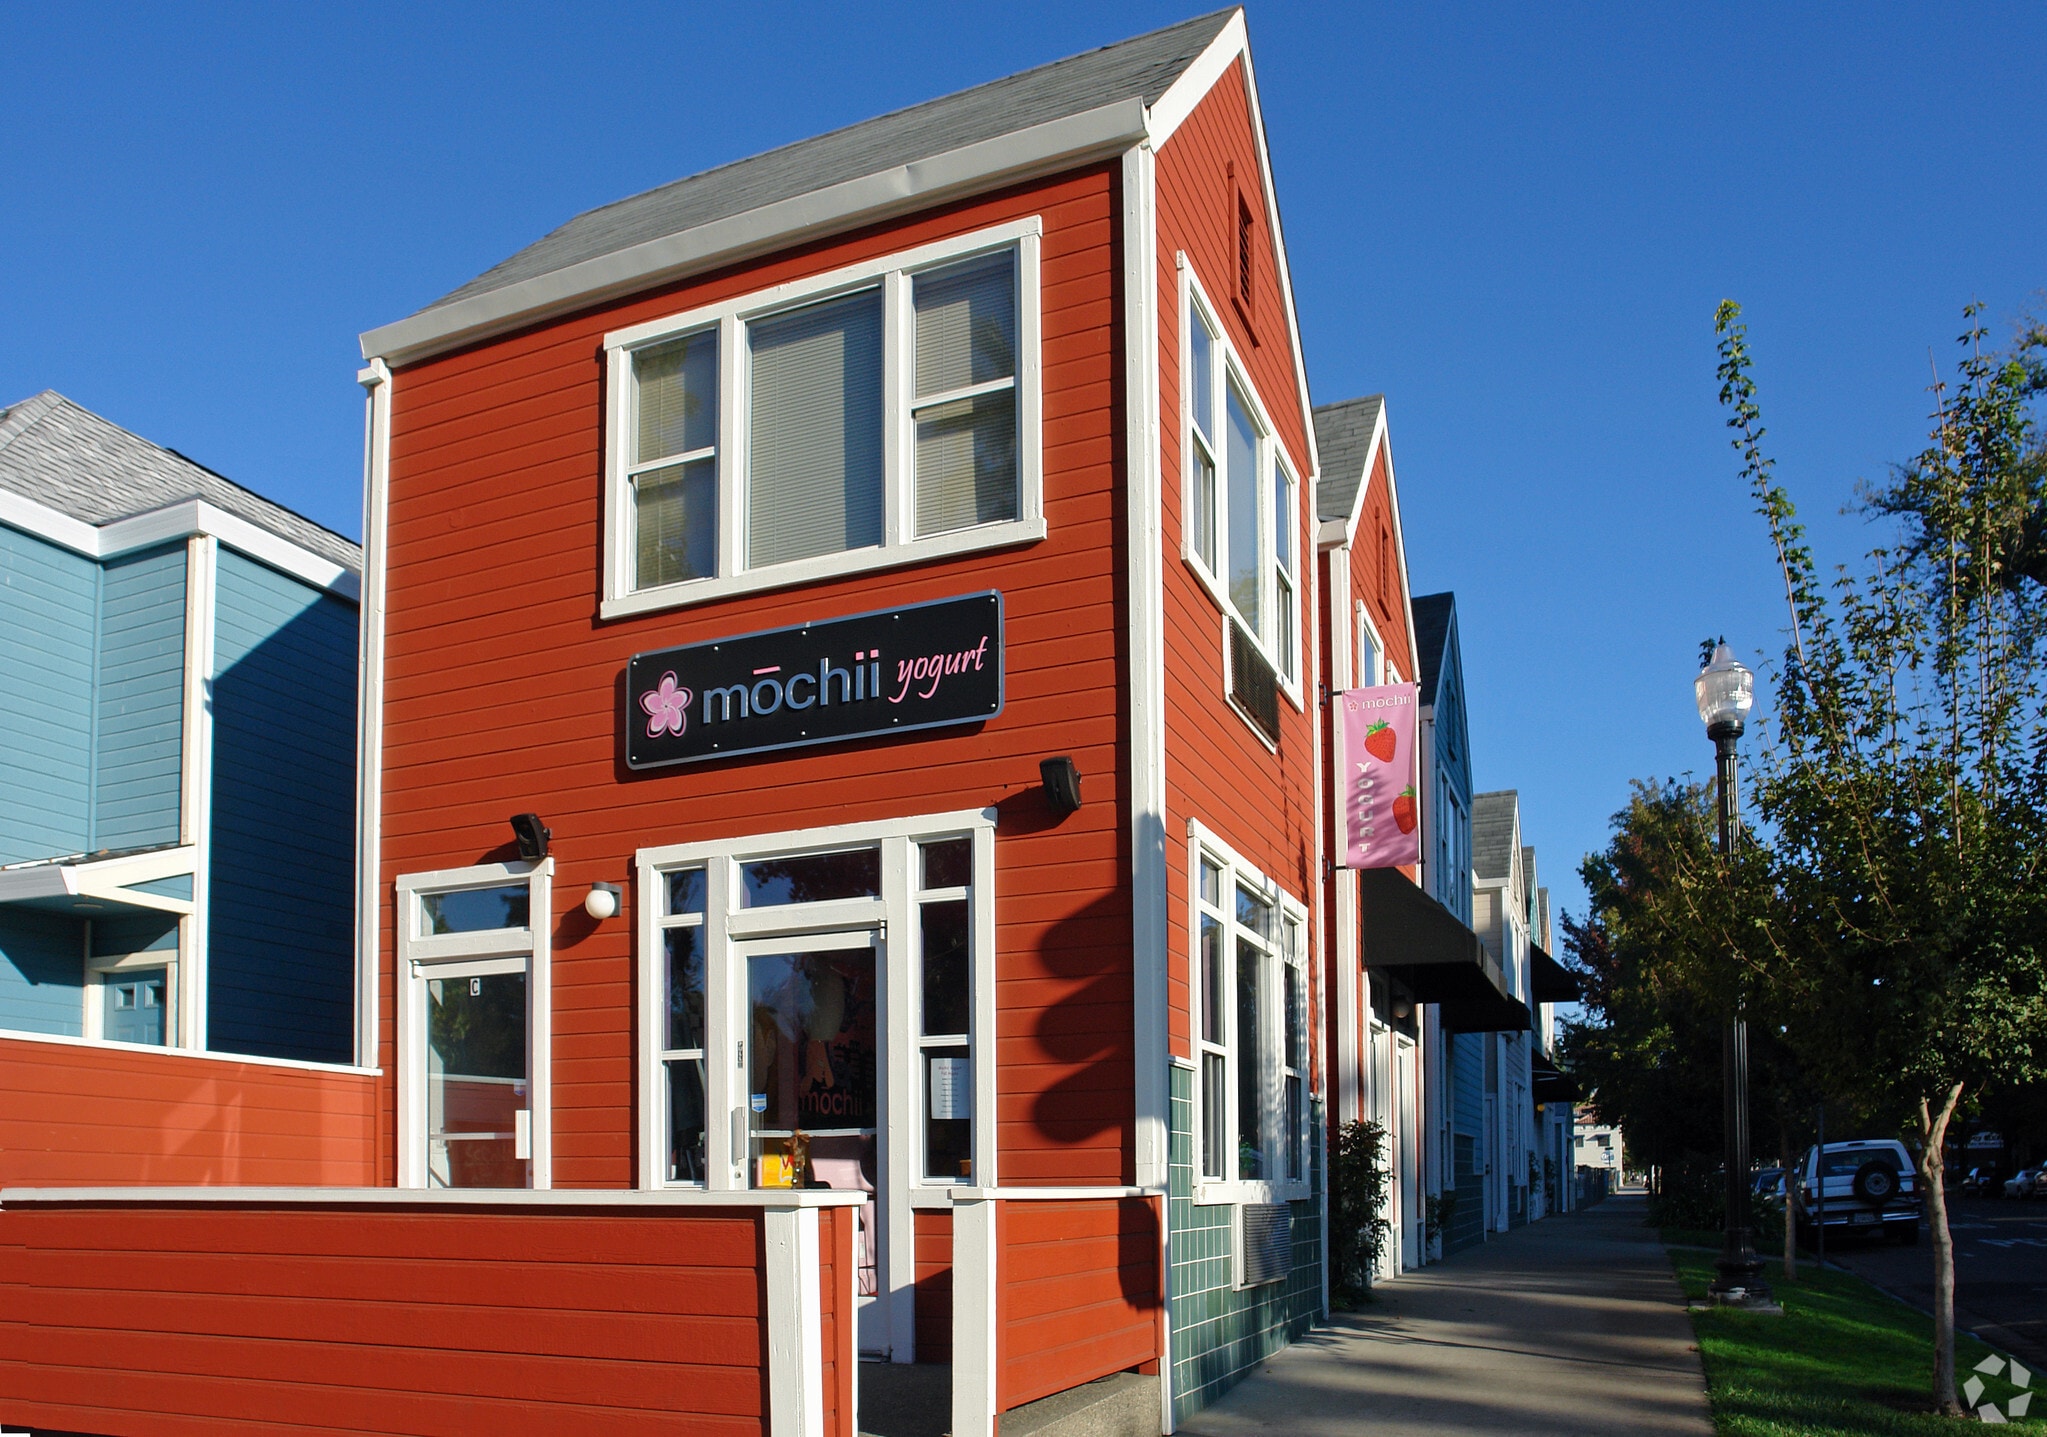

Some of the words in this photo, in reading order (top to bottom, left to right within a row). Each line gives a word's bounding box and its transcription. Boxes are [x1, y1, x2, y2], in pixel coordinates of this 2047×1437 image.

[887, 635, 989, 704] yogurt
[1356, 761, 1375, 854] YOGURT
[471, 979, 479, 994] C
